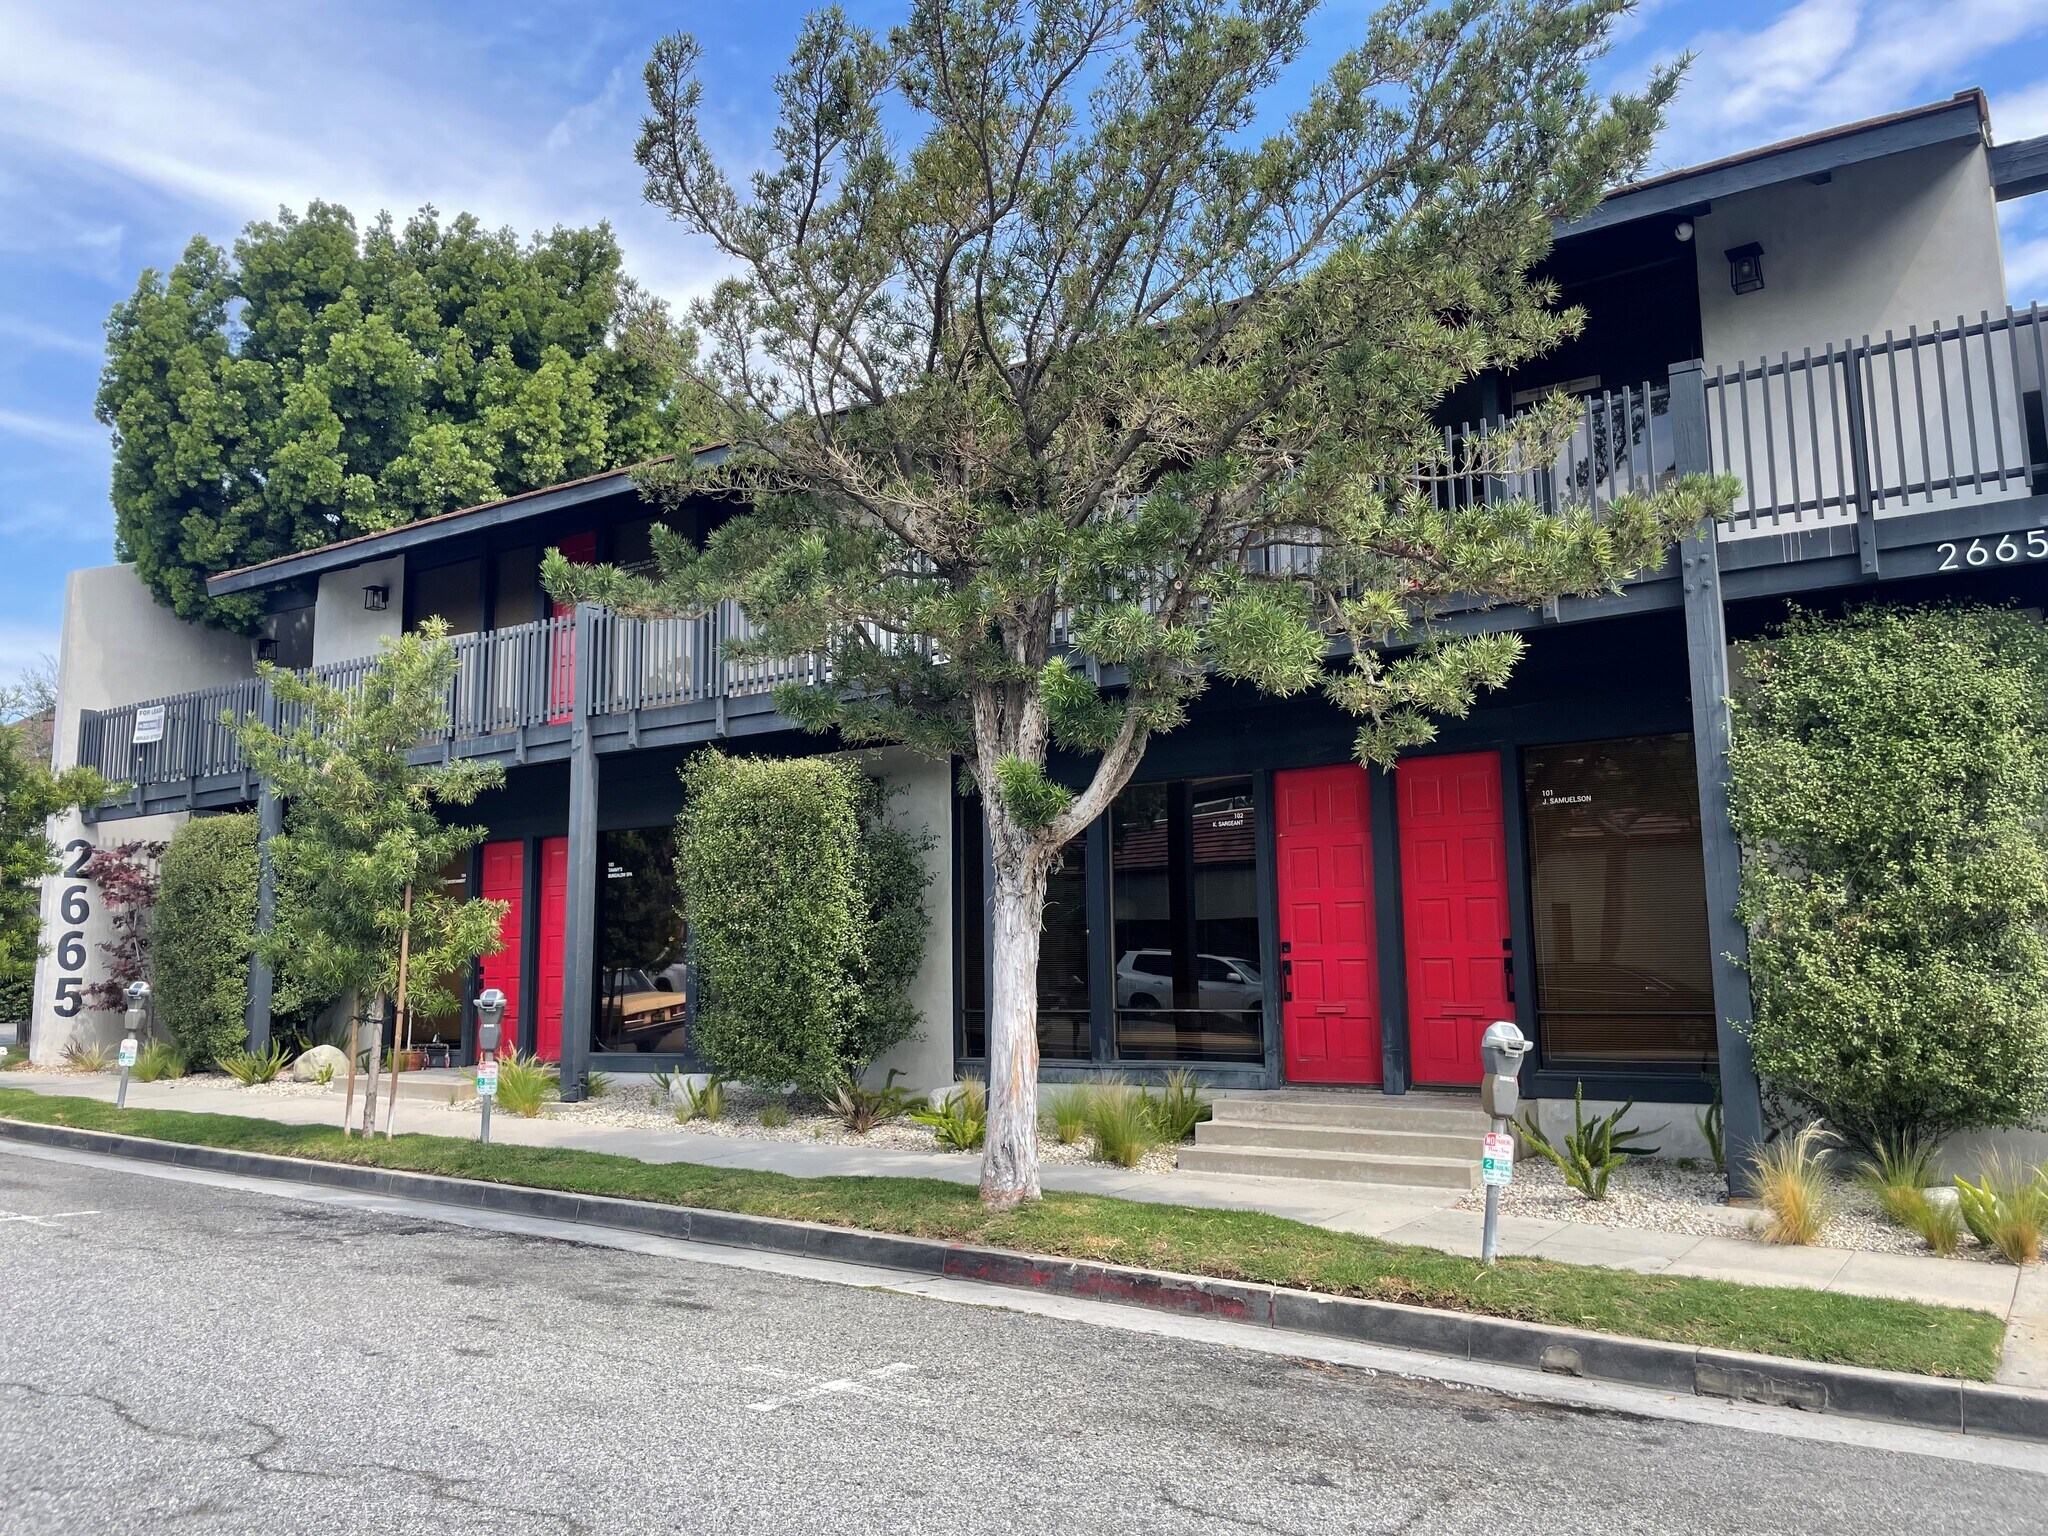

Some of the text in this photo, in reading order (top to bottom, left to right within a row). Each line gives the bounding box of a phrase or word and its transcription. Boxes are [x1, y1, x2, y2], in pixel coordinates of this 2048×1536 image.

[1936, 529, 2048, 571] 2665
[151, 706, 164, 715] LEASE
[1541, 789, 1553, 797] 101
[1549, 794, 1592, 805] SAMUELSON
[1218, 819, 1244, 827] SARGEANT
[53, 838, 93, 1018] 2665
[1485, 1136, 1495, 1146] NO
[1485, 1159, 1492, 1169] 2
